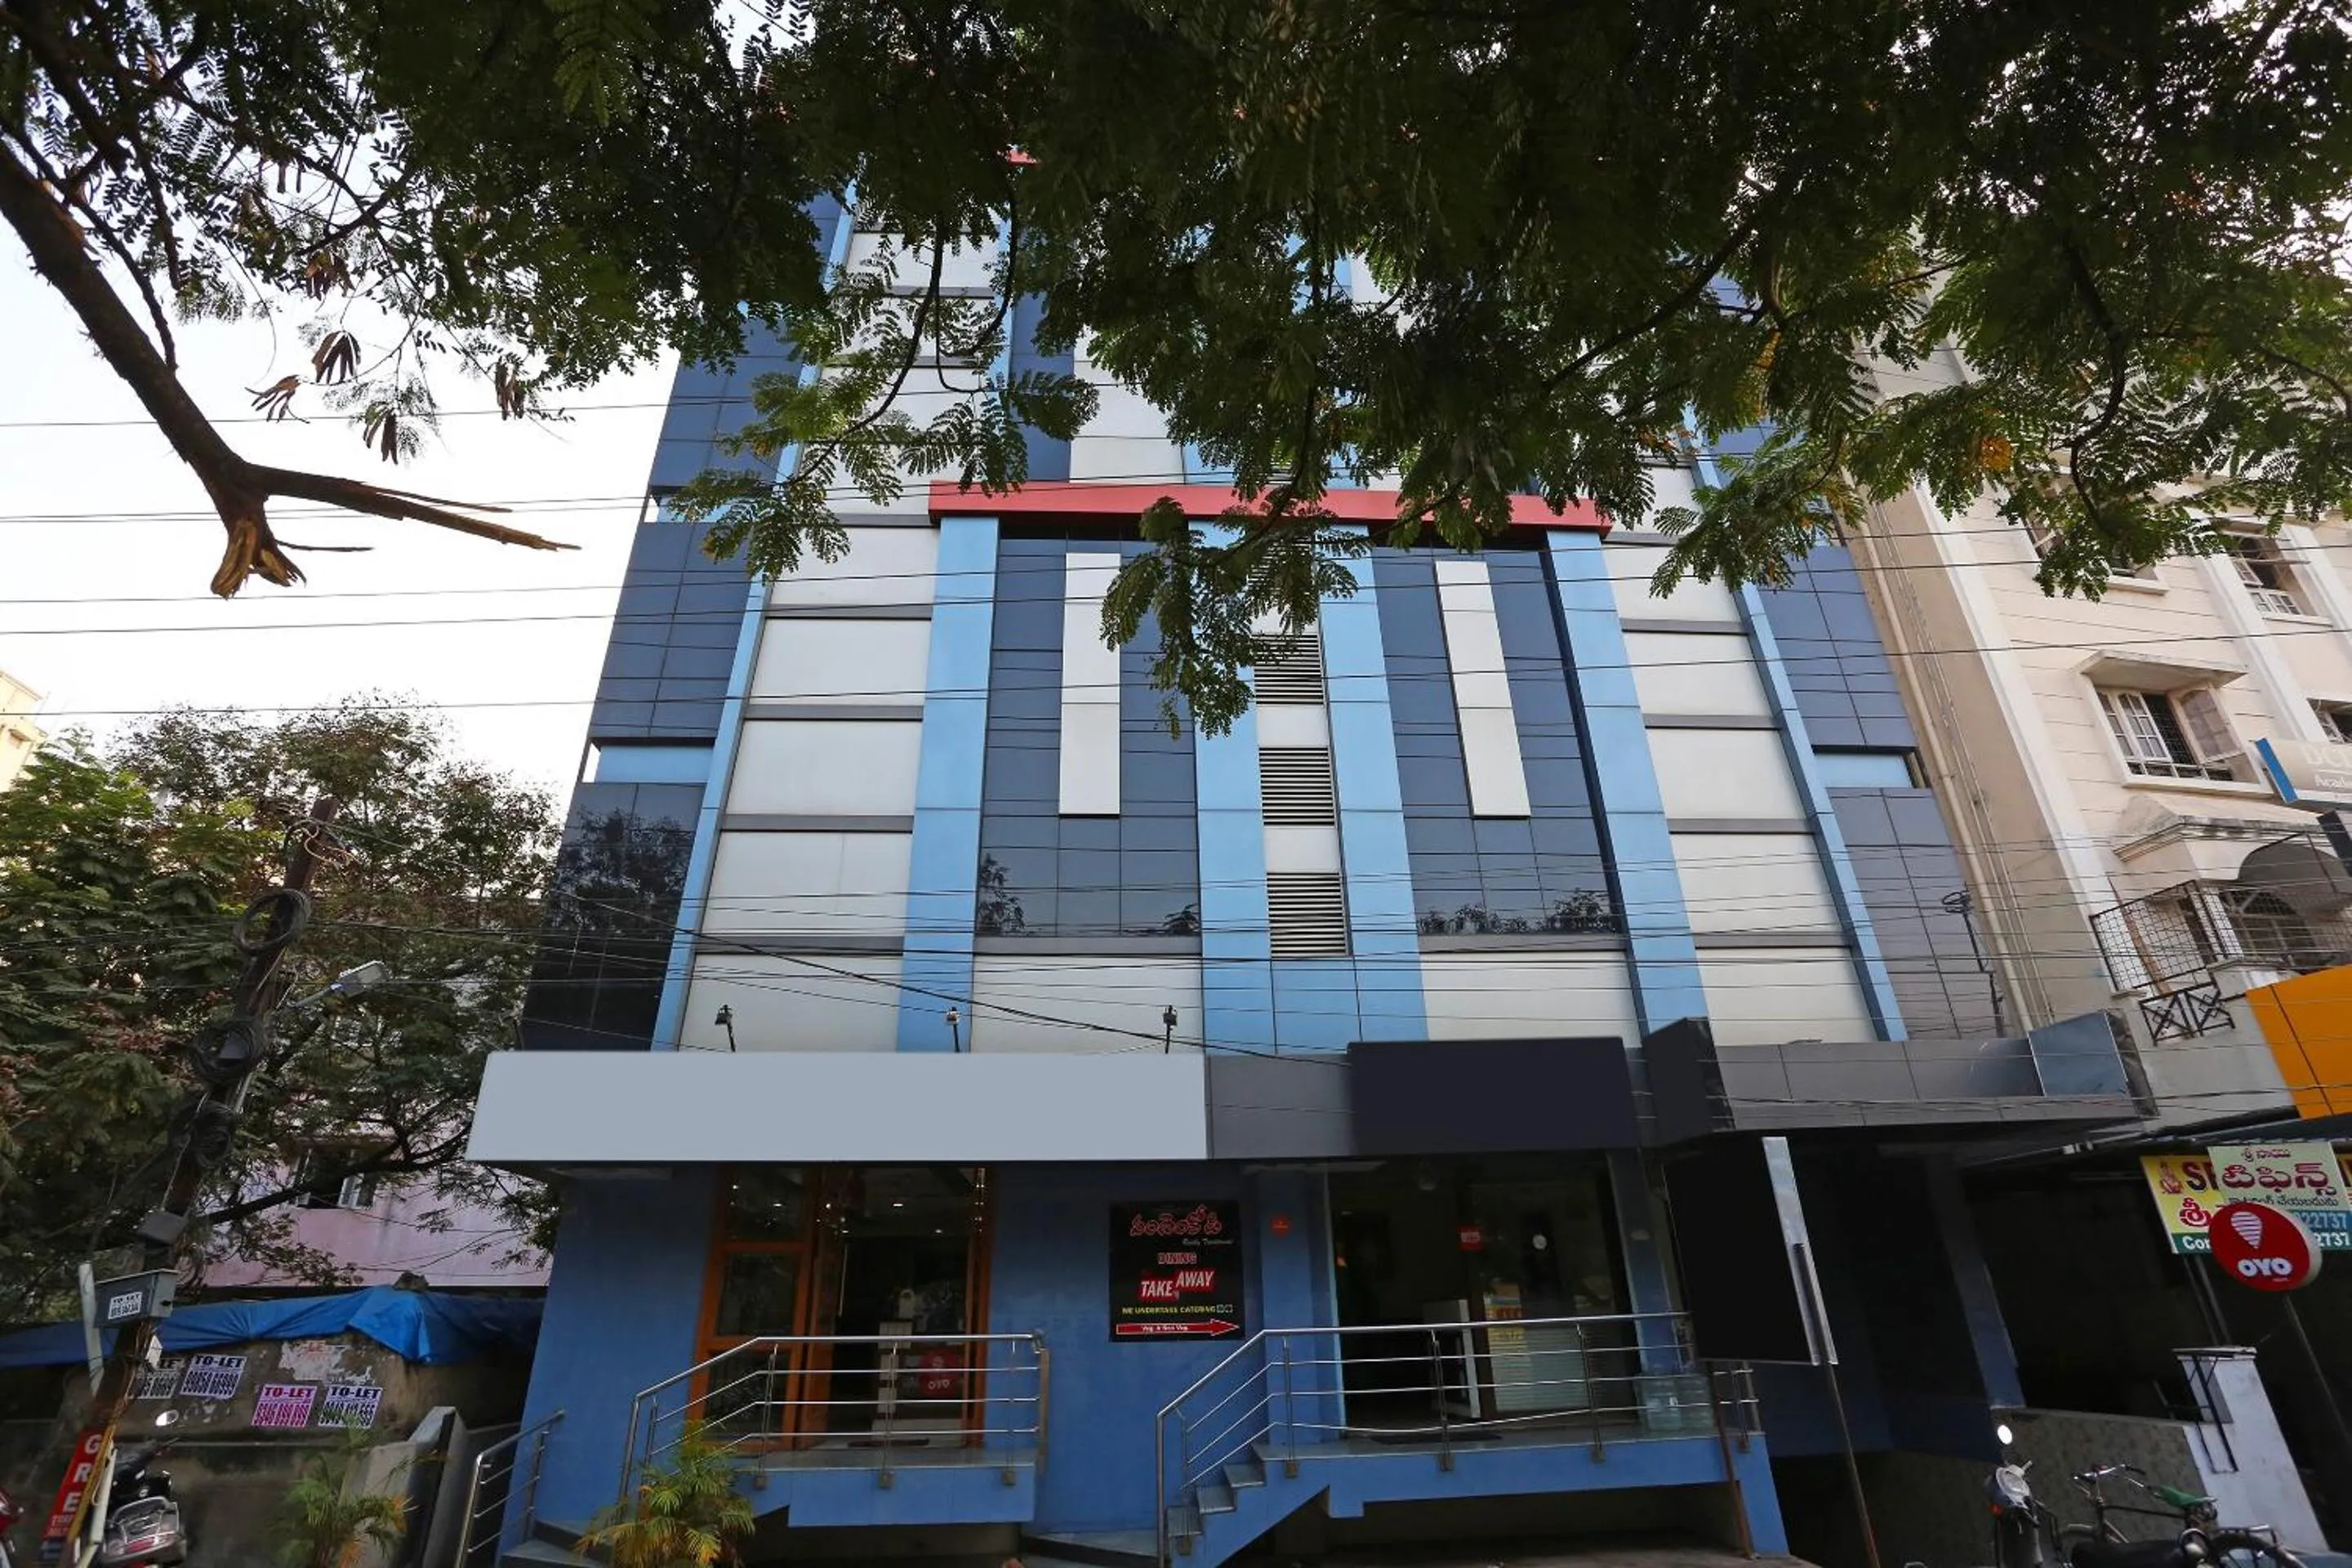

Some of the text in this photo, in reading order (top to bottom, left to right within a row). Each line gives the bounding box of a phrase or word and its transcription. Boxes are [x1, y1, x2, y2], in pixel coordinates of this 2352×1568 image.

[1158, 1253, 1196, 1264] DINING
[2238, 1258, 2292, 1276] OYO
[1141, 1271, 1214, 1297] TAKE AWAY
[195, 1356, 243, 1368] TO-LET
[265, 1387, 314, 1399] TO-LET
[331, 1388, 381, 1399] TO-LET
